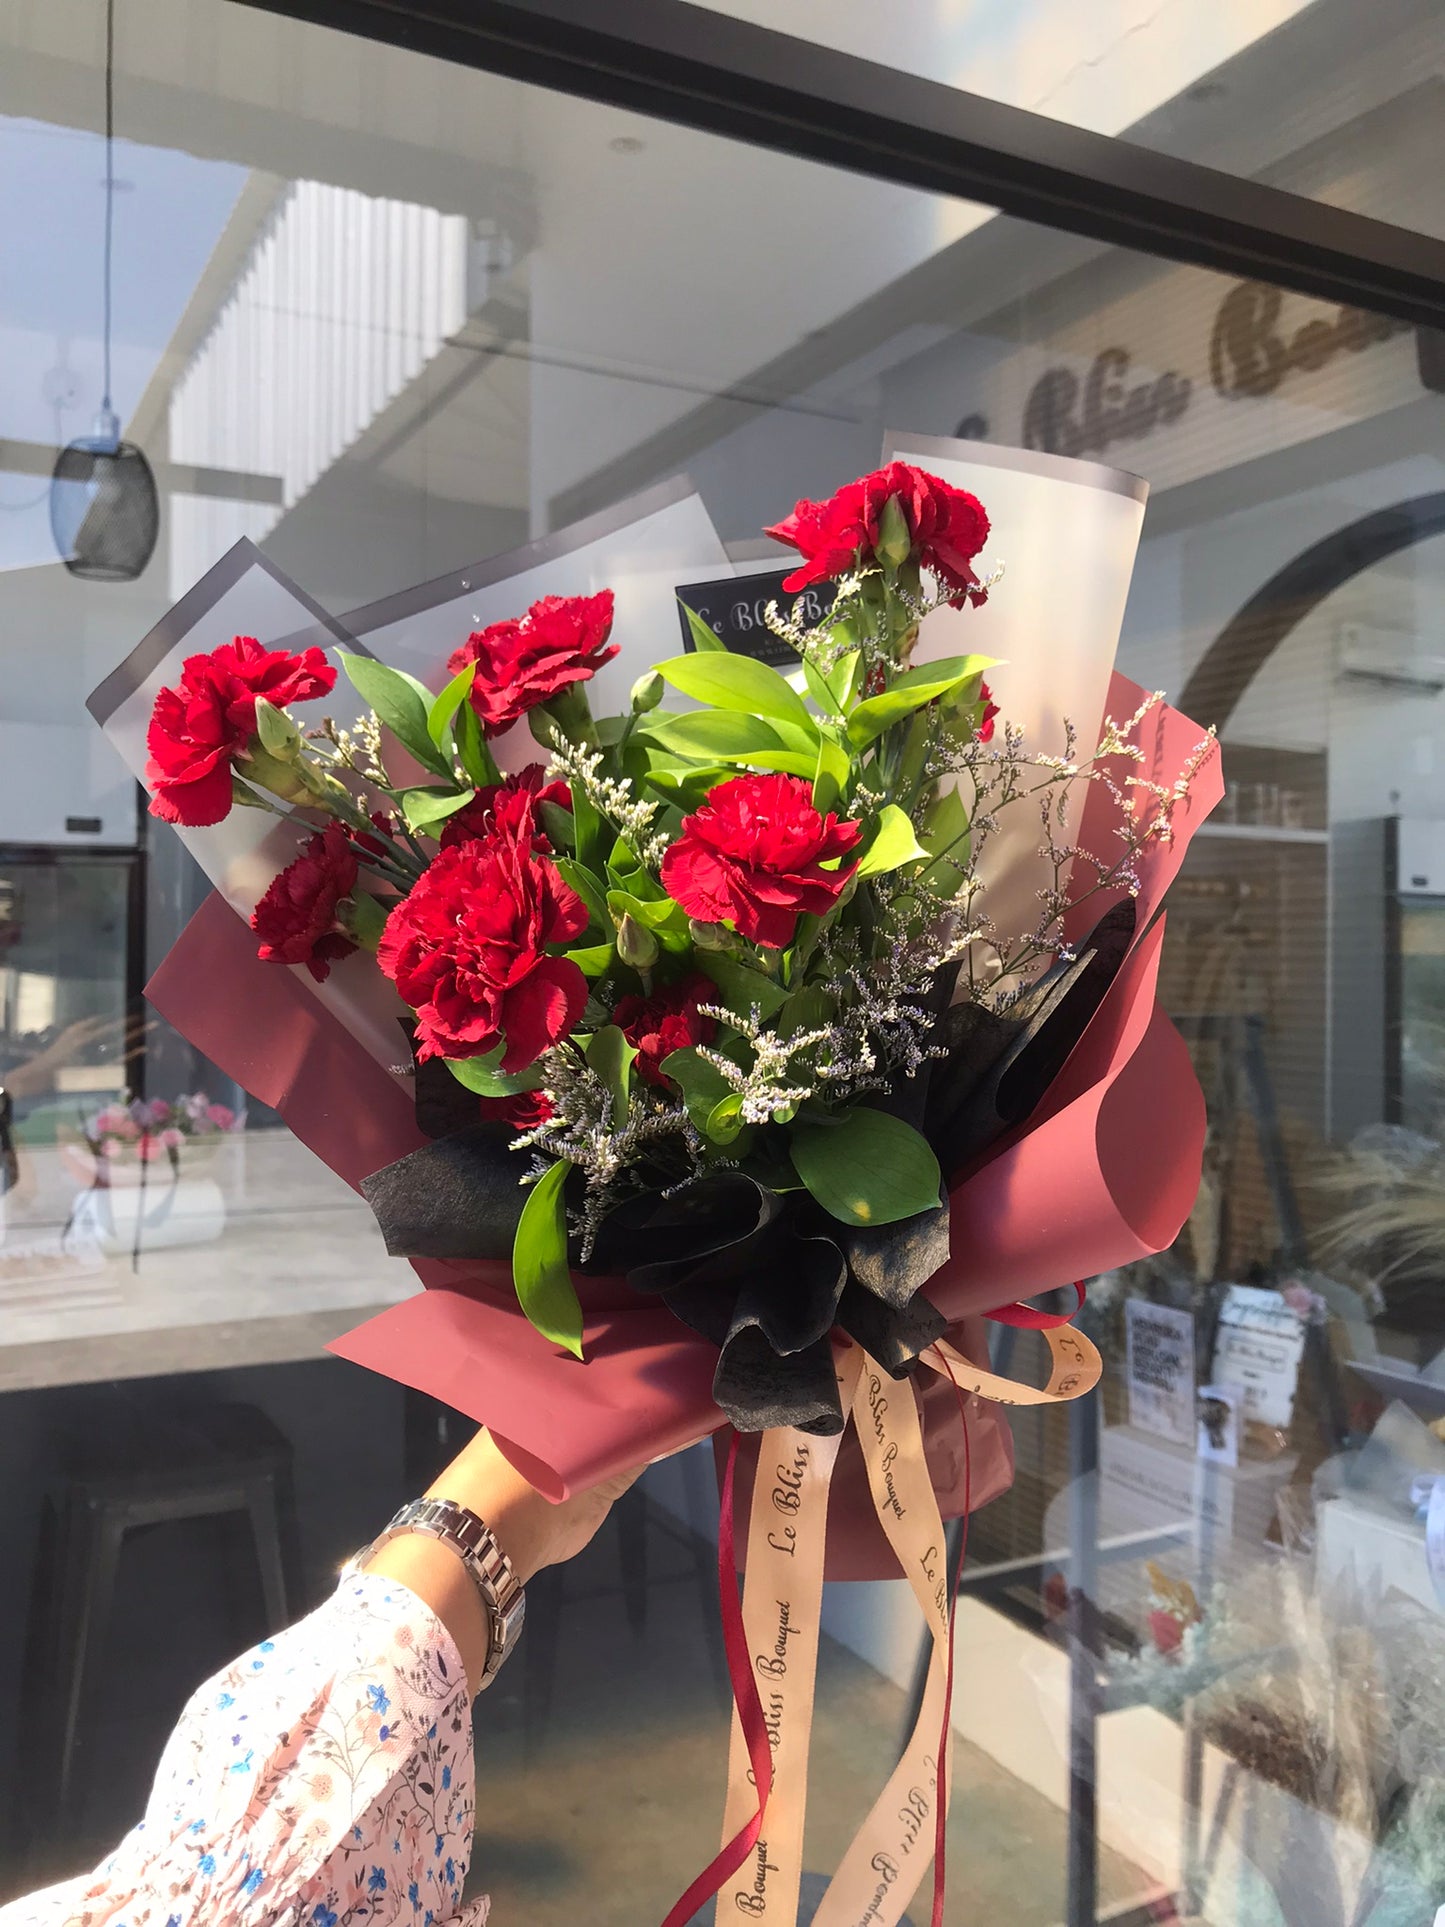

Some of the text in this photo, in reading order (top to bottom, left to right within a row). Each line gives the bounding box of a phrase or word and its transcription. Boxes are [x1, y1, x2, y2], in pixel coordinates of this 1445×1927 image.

[767, 1442, 809, 1557] Le Bliss
[882, 1442, 906, 1520] Bouquet
[920, 1546, 937, 1583] Le
[756, 1600, 801, 1681] Bouquet
[735, 1840, 780, 1919] Bouquet
